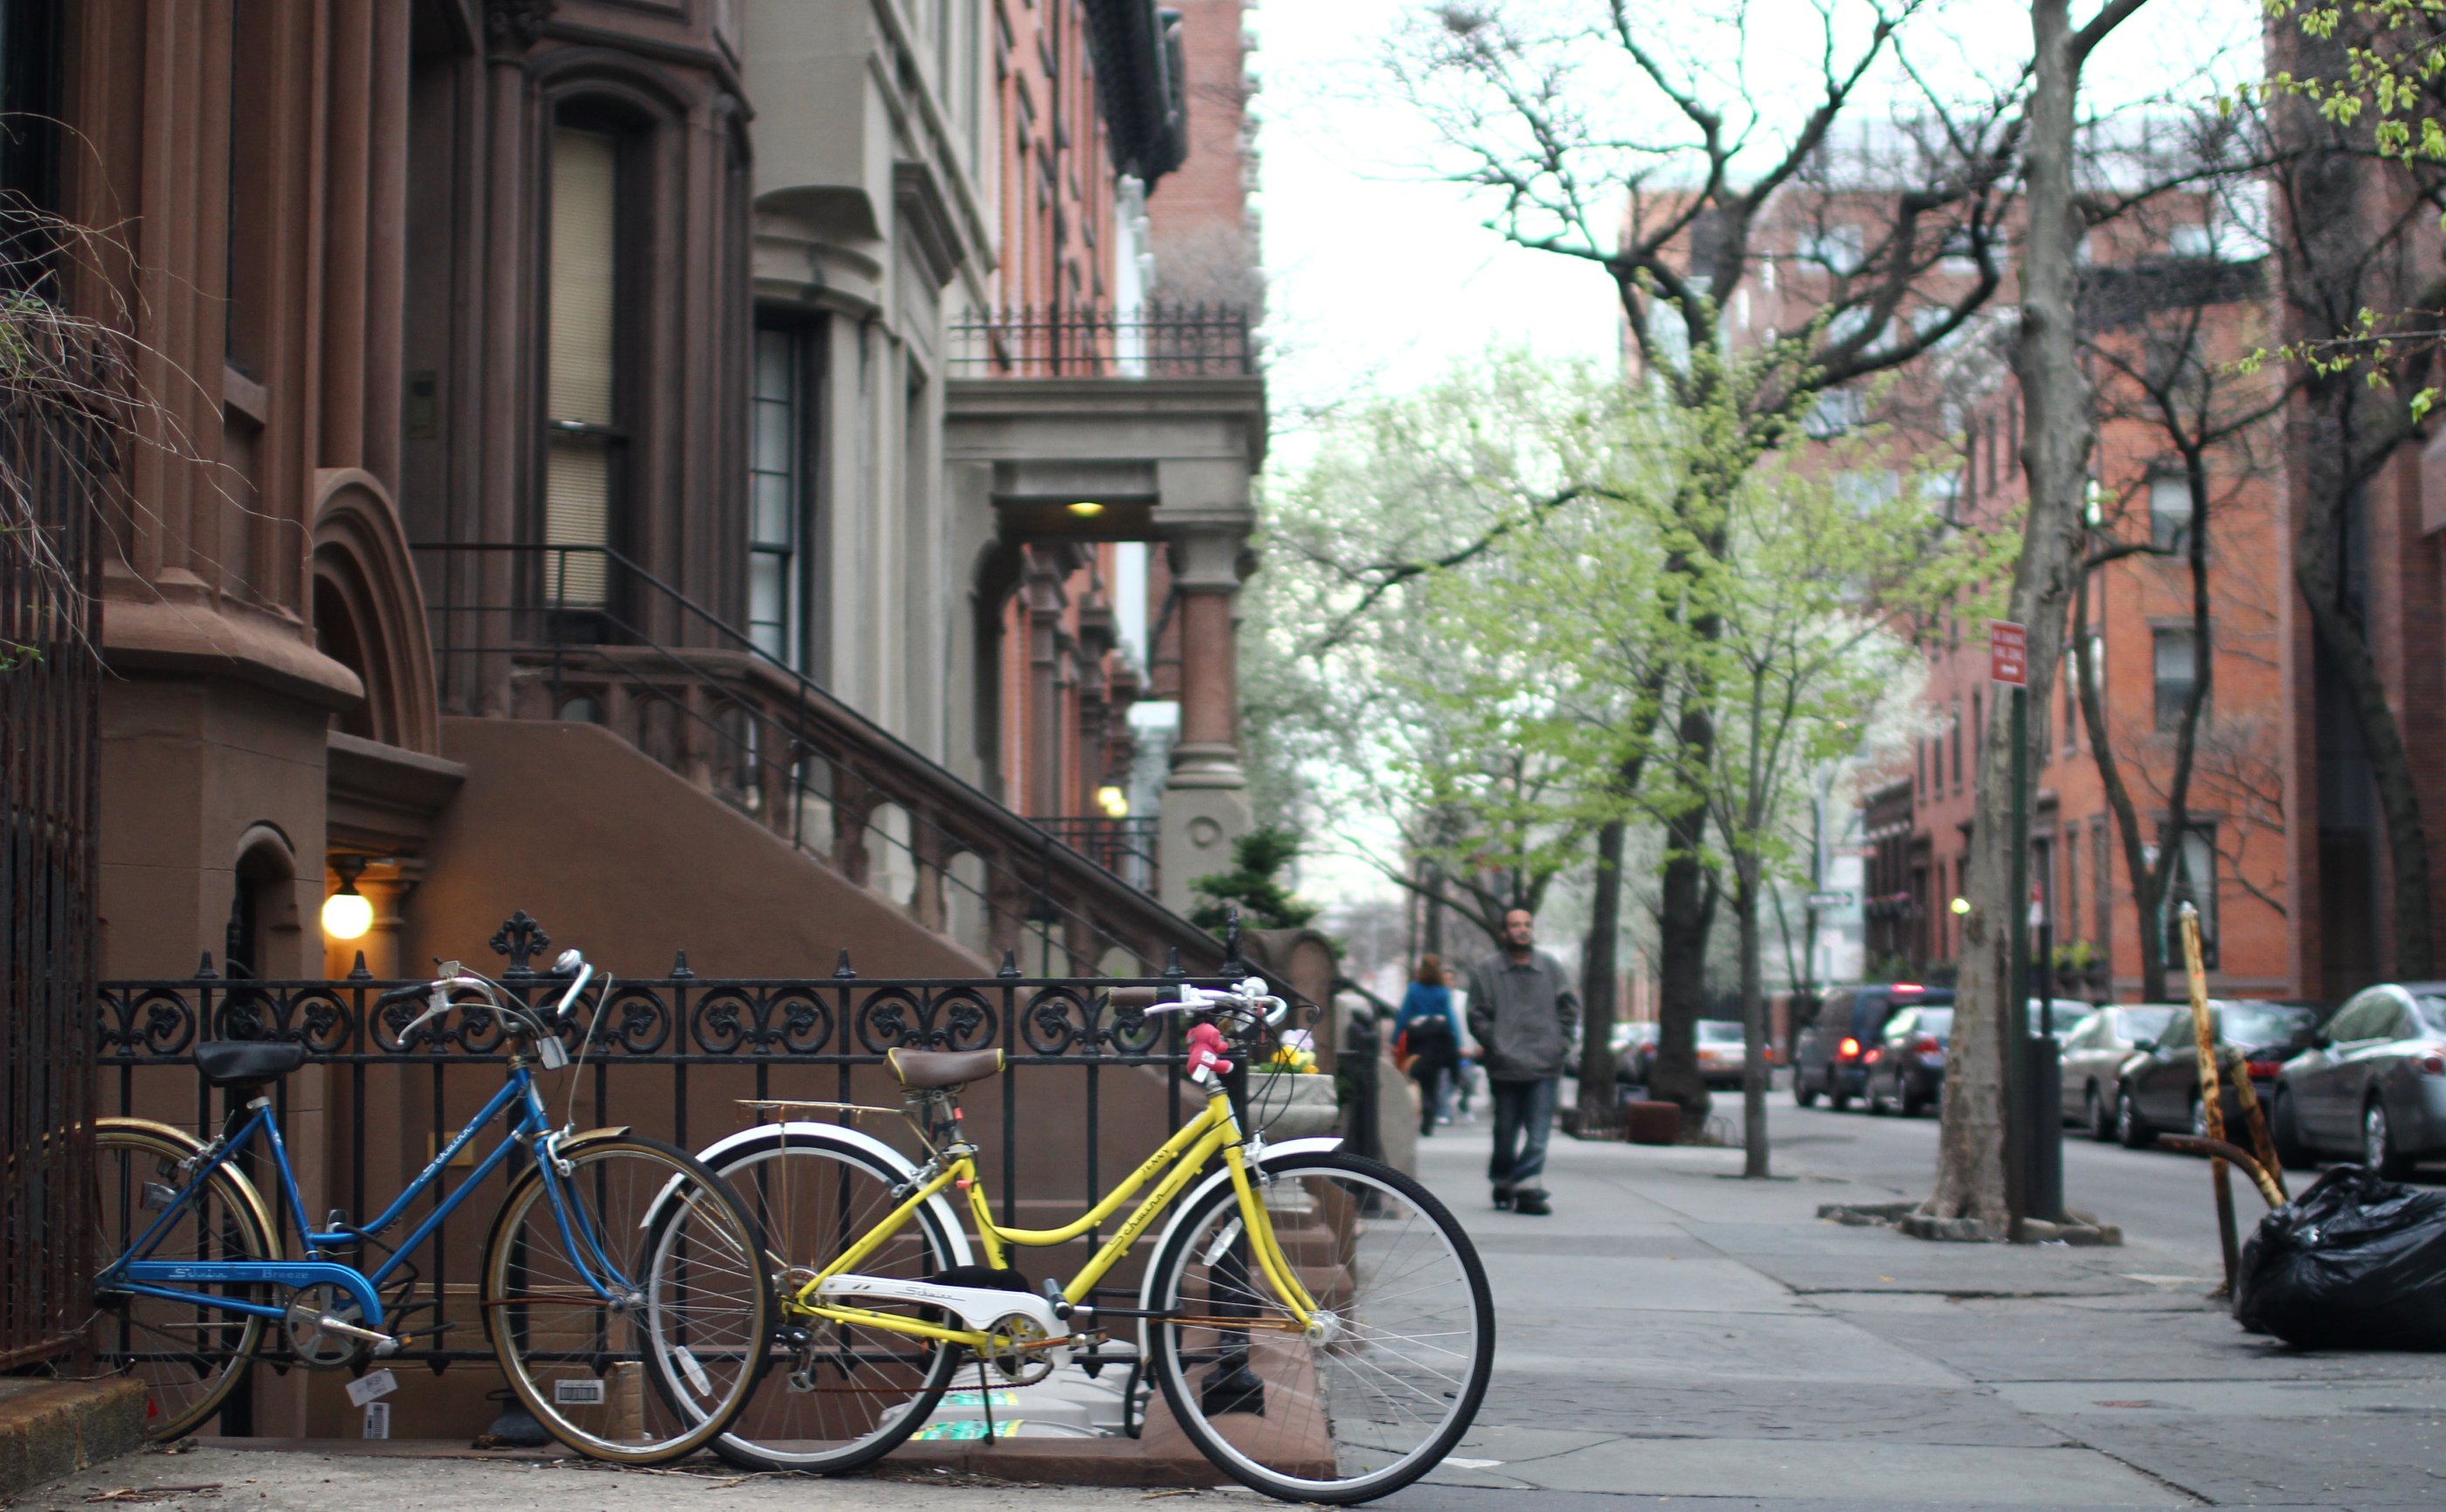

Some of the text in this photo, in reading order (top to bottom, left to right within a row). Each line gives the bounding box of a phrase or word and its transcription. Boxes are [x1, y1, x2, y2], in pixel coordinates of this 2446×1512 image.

[420, 1127, 473, 1182] Schwinn
[1102, 1179, 1178, 1262] Schwinn
[262, 1269, 309, 1279] Breeze
